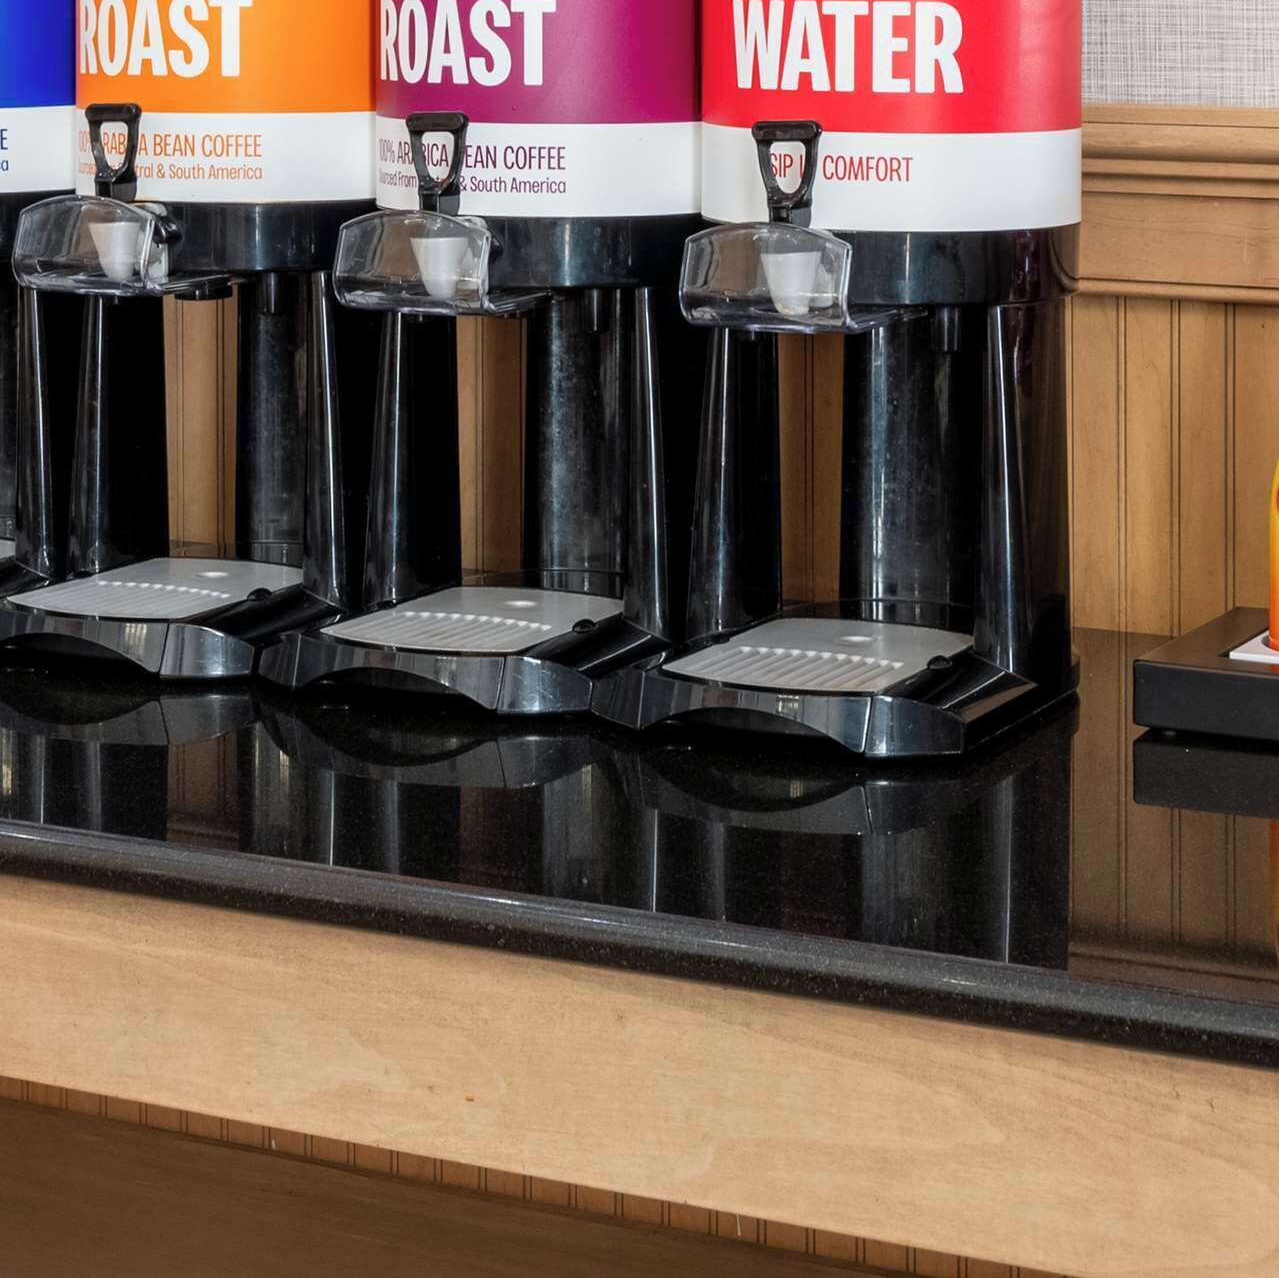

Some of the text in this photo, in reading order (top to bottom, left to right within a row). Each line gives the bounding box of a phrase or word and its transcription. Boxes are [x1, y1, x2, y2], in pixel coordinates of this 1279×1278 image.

[153, 134, 195, 157] BEAN
[201, 134, 262, 158] COFFEE
[464, 144, 497, 170] EAN
[503, 145, 566, 170] COFFEE
[157, 163, 165, 179] &
[170, 162, 205, 179] South
[208, 164, 262, 180] America
[770, 153, 793, 179] SIP
[822, 155, 913, 182] COMFORT
[470, 176, 507, 193] South
[510, 176, 566, 194] America
